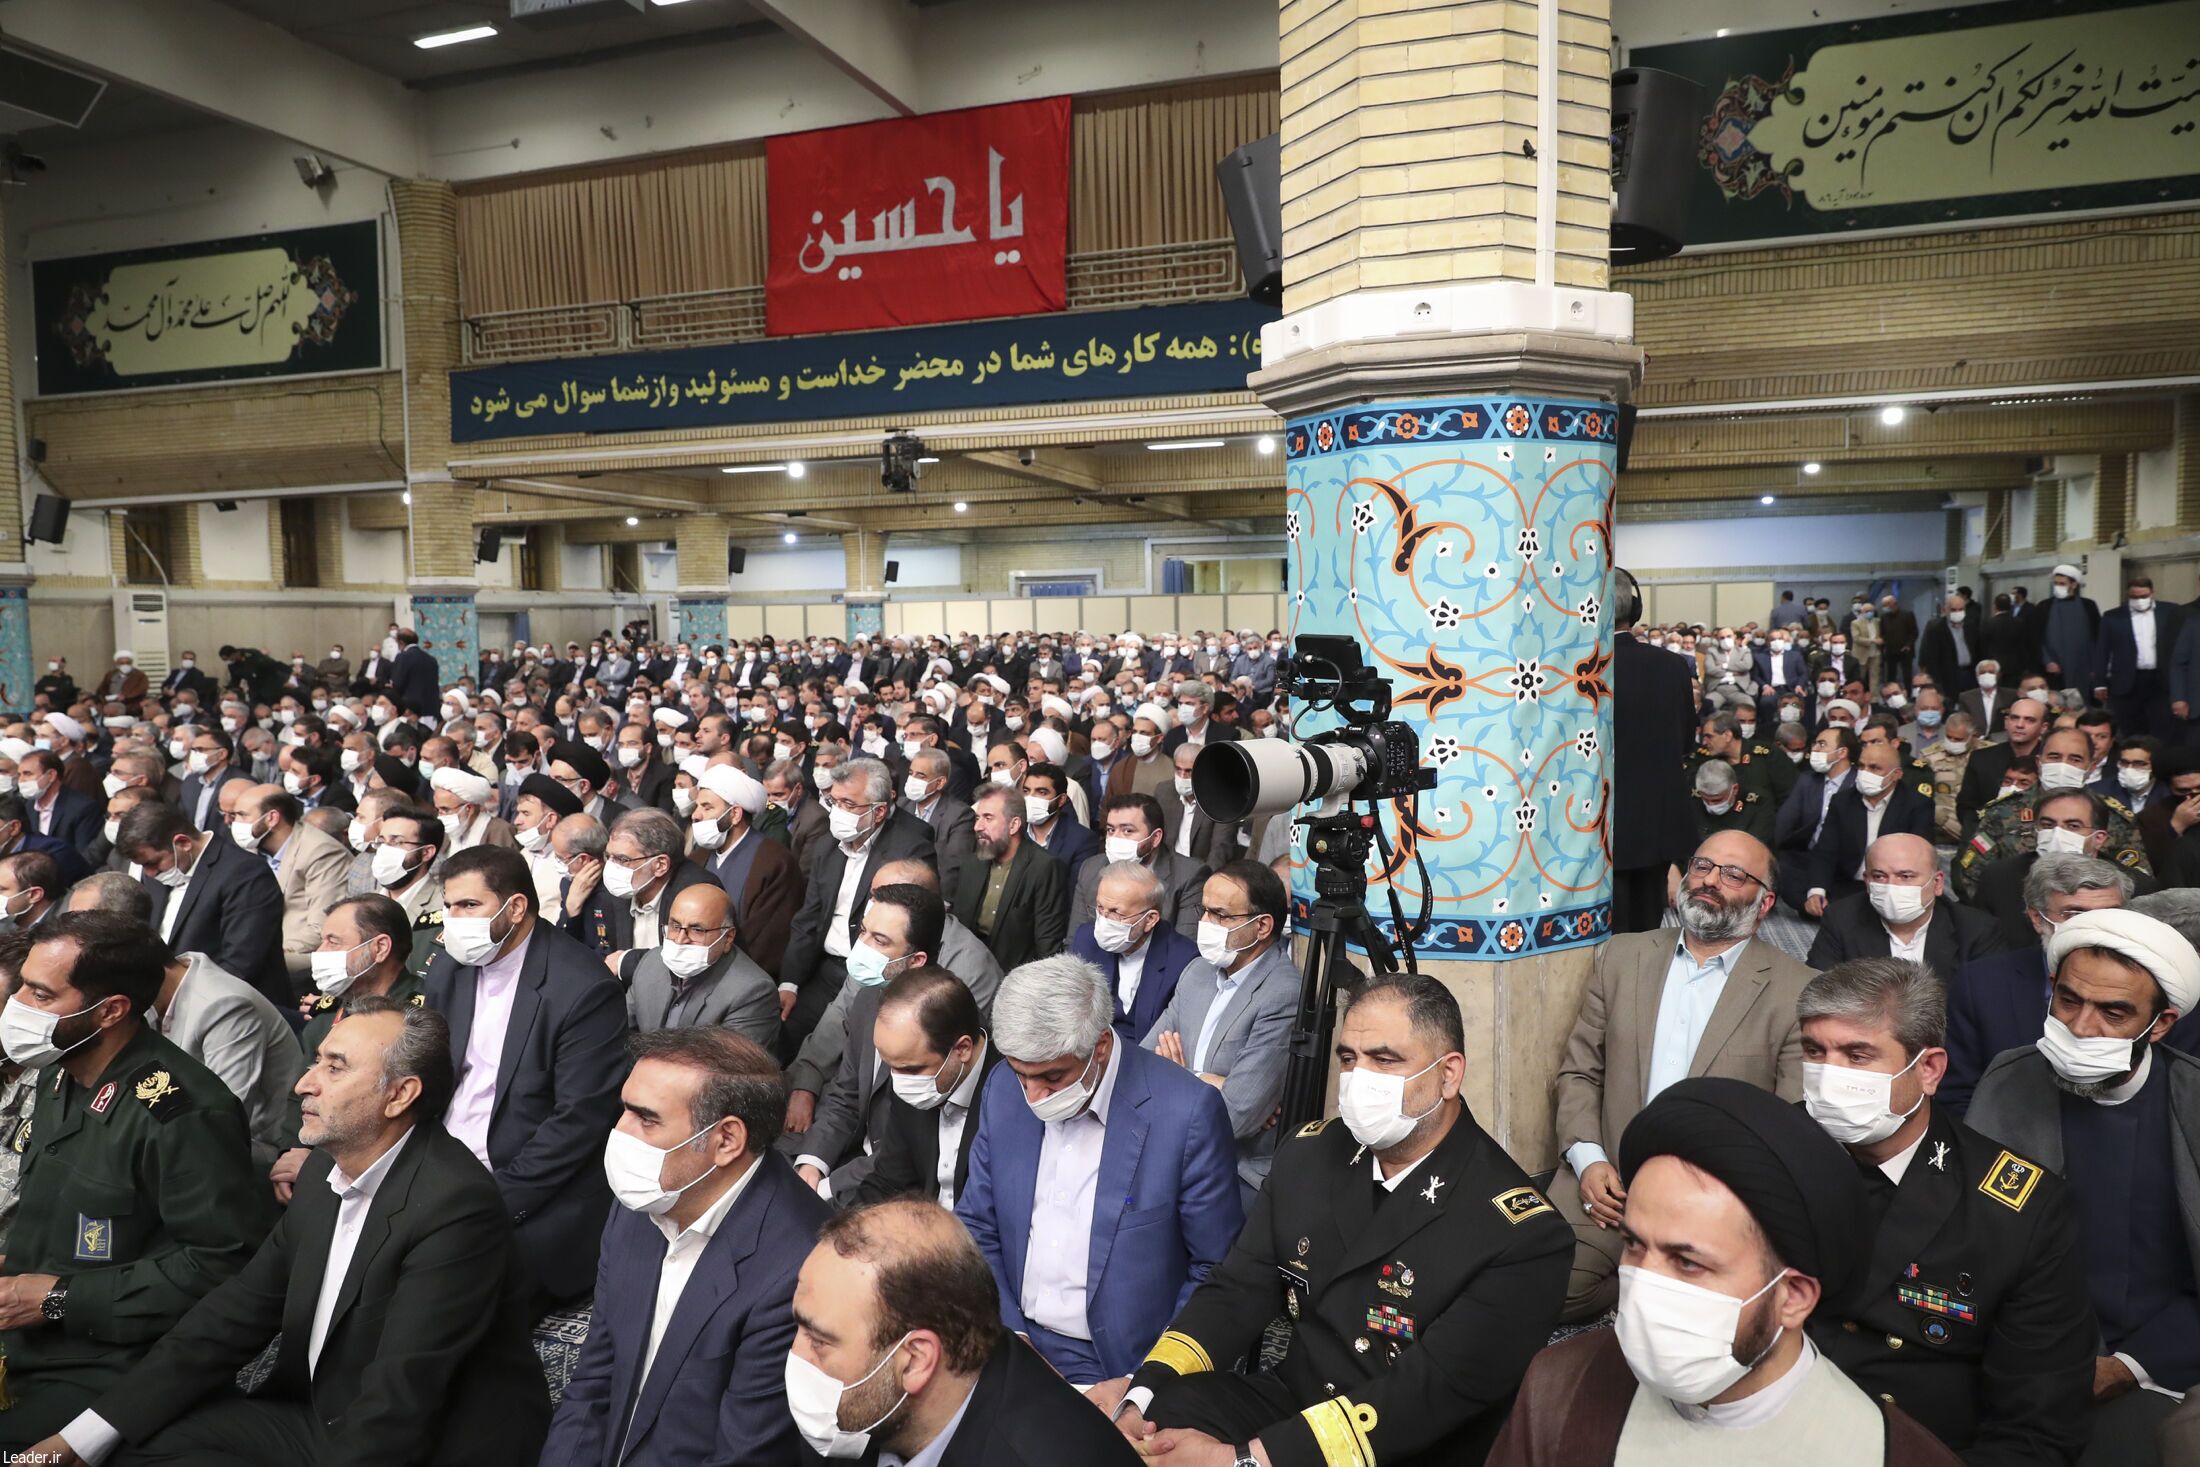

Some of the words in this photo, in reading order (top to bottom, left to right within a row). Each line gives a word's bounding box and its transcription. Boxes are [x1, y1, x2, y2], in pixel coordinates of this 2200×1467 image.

[989, 145, 1023, 266] یا
[798, 176, 976, 281] حسین
[1009, 341, 1054, 372] شما
[1165, 335, 1217, 359] همه
[892, 352, 964, 391] محضر
[971, 350, 1001, 385] در
[470, 387, 510, 422] شود
